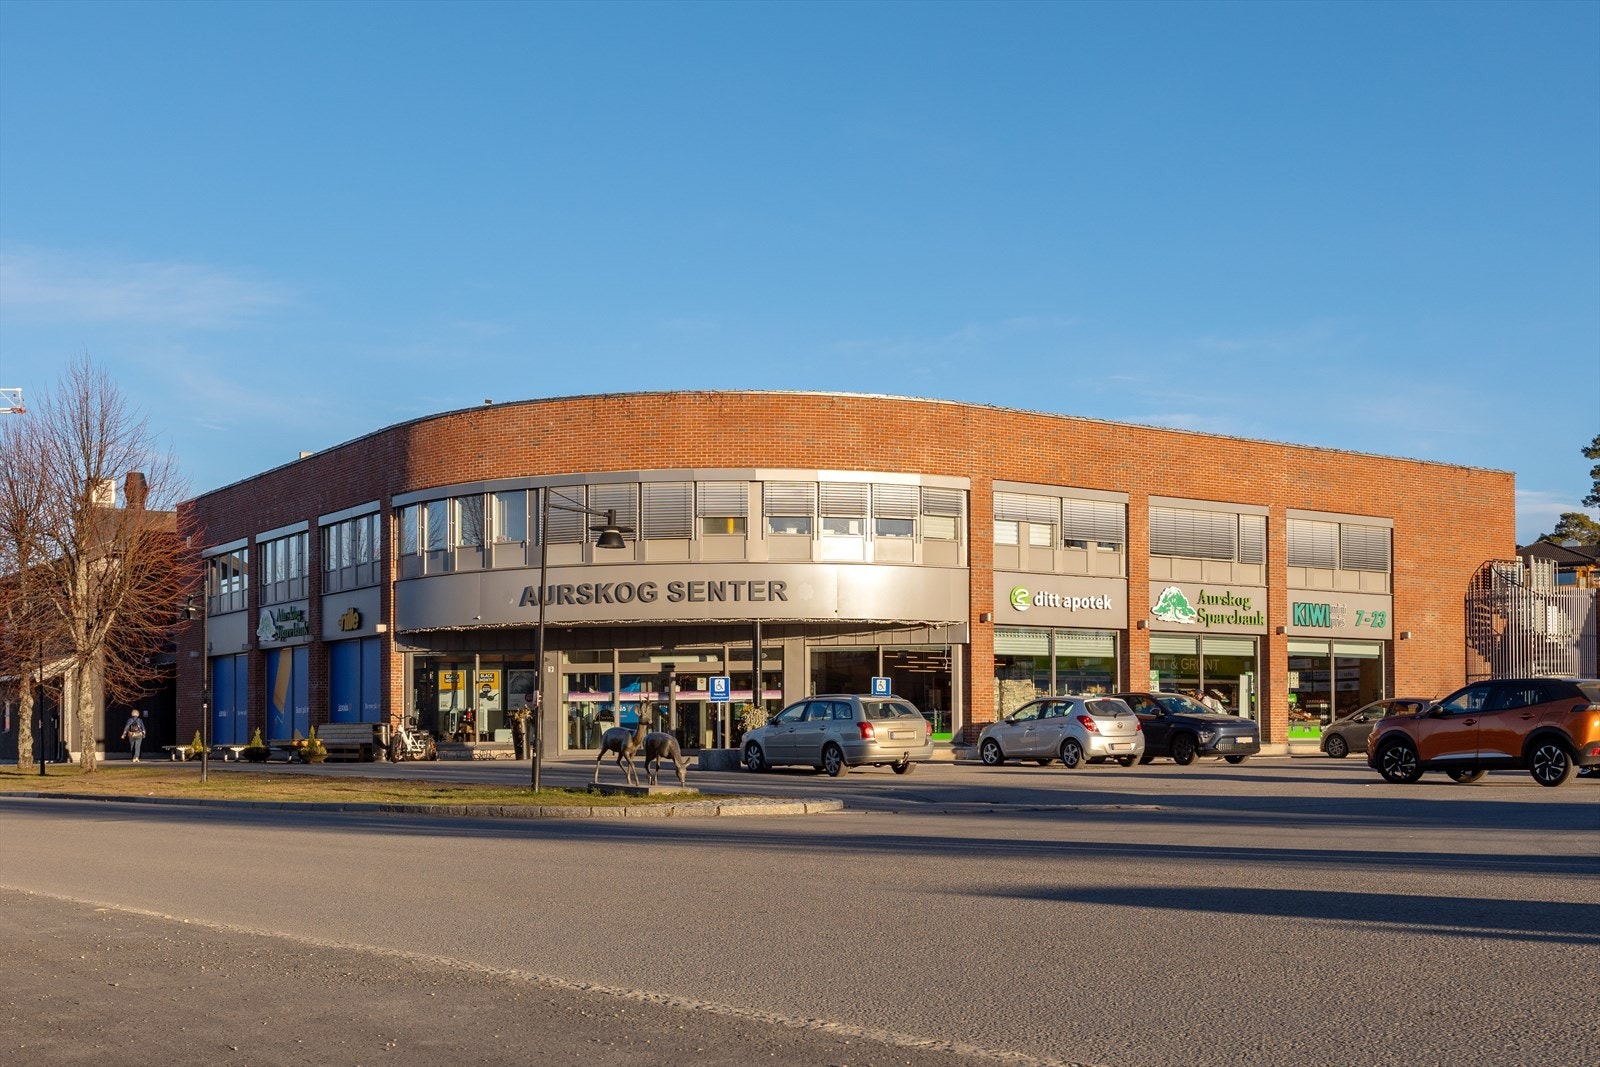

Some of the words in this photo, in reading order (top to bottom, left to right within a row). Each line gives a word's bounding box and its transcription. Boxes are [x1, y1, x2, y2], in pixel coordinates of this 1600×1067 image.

[519, 582, 658, 607] AURSKOG
[667, 580, 788, 602] SENTER
[1033, 591, 1060, 607] ditt
[1062, 594, 1113, 612] apotek
[1197, 589, 1252, 611] Aurskog
[1197, 608, 1264, 627] Sparebank
[1293, 602, 1331, 628] KIWI
[1170, 658, 1178, 669] &
